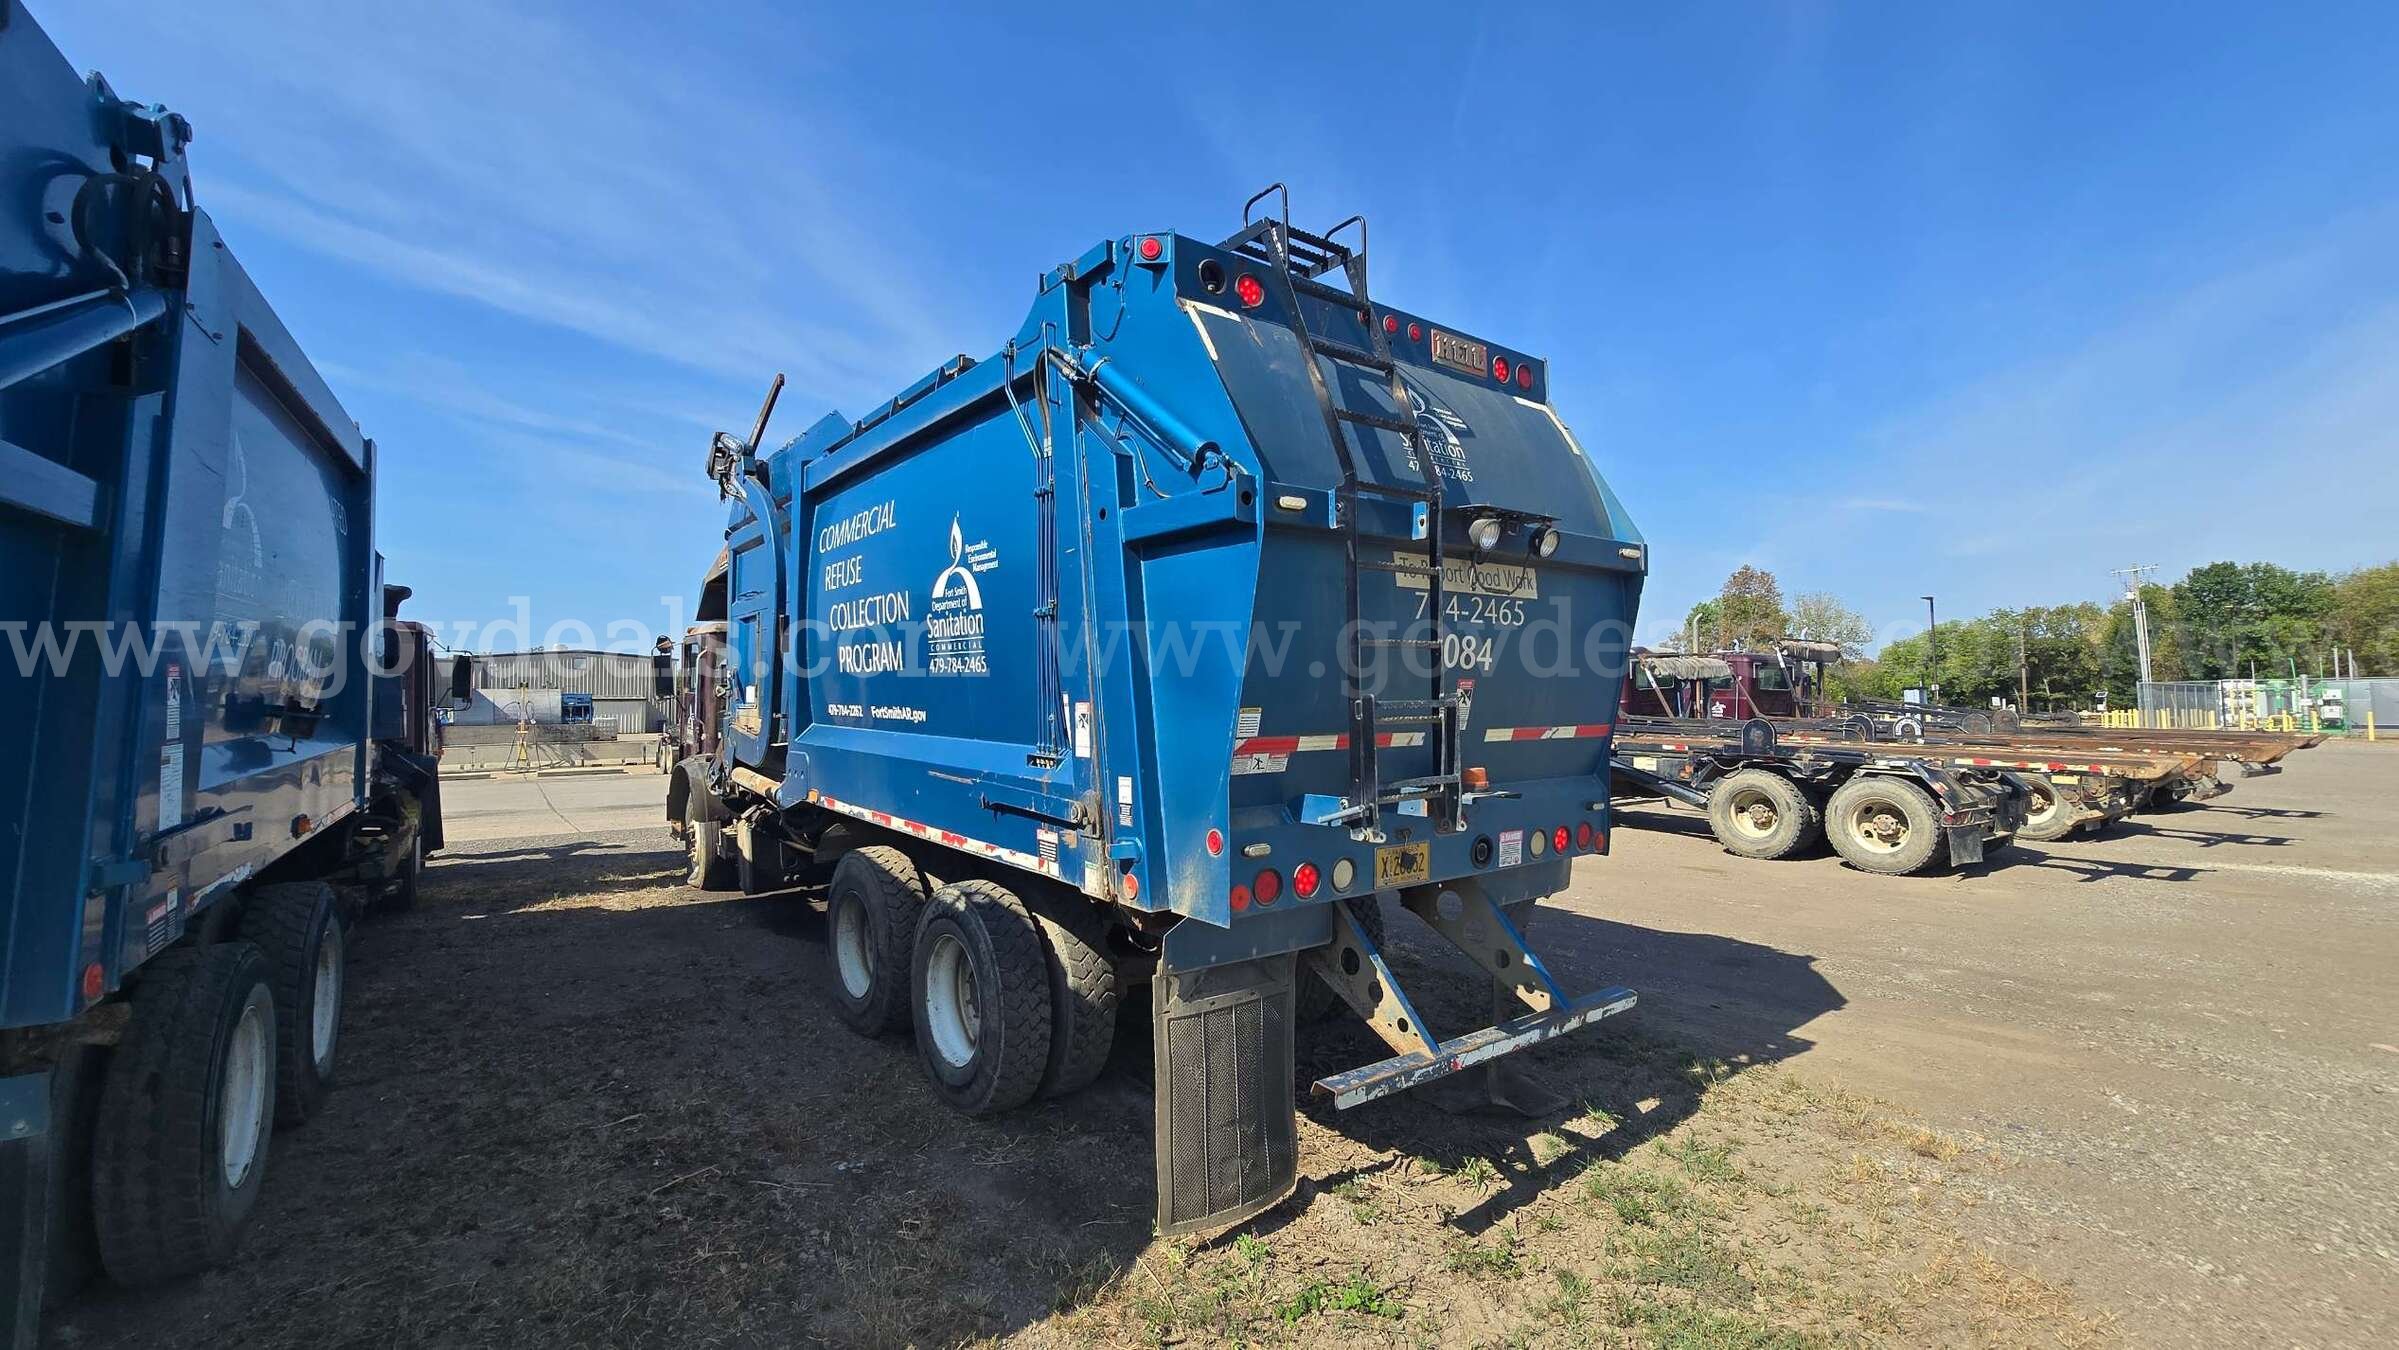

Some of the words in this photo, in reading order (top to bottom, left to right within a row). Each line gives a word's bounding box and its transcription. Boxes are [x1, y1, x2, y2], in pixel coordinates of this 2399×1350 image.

[1400, 432, 1466, 460] Sitation
[819, 500, 896, 554] COMMERCIAL
[825, 555, 863, 592] REFUSE
[1503, 569, 1535, 591] Work
[830, 590, 910, 632] COLLECTION
[932, 598, 961, 612] Department
[961, 597, 968, 607] of
[1415, 592, 1525, 626] 74-2465
[927, 608, 984, 639] Sanitation
[839, 641, 903, 673] PROGRAM
[930, 641, 982, 652] COMMERCIAL
[929, 656, 987, 674] 479-784-2465
